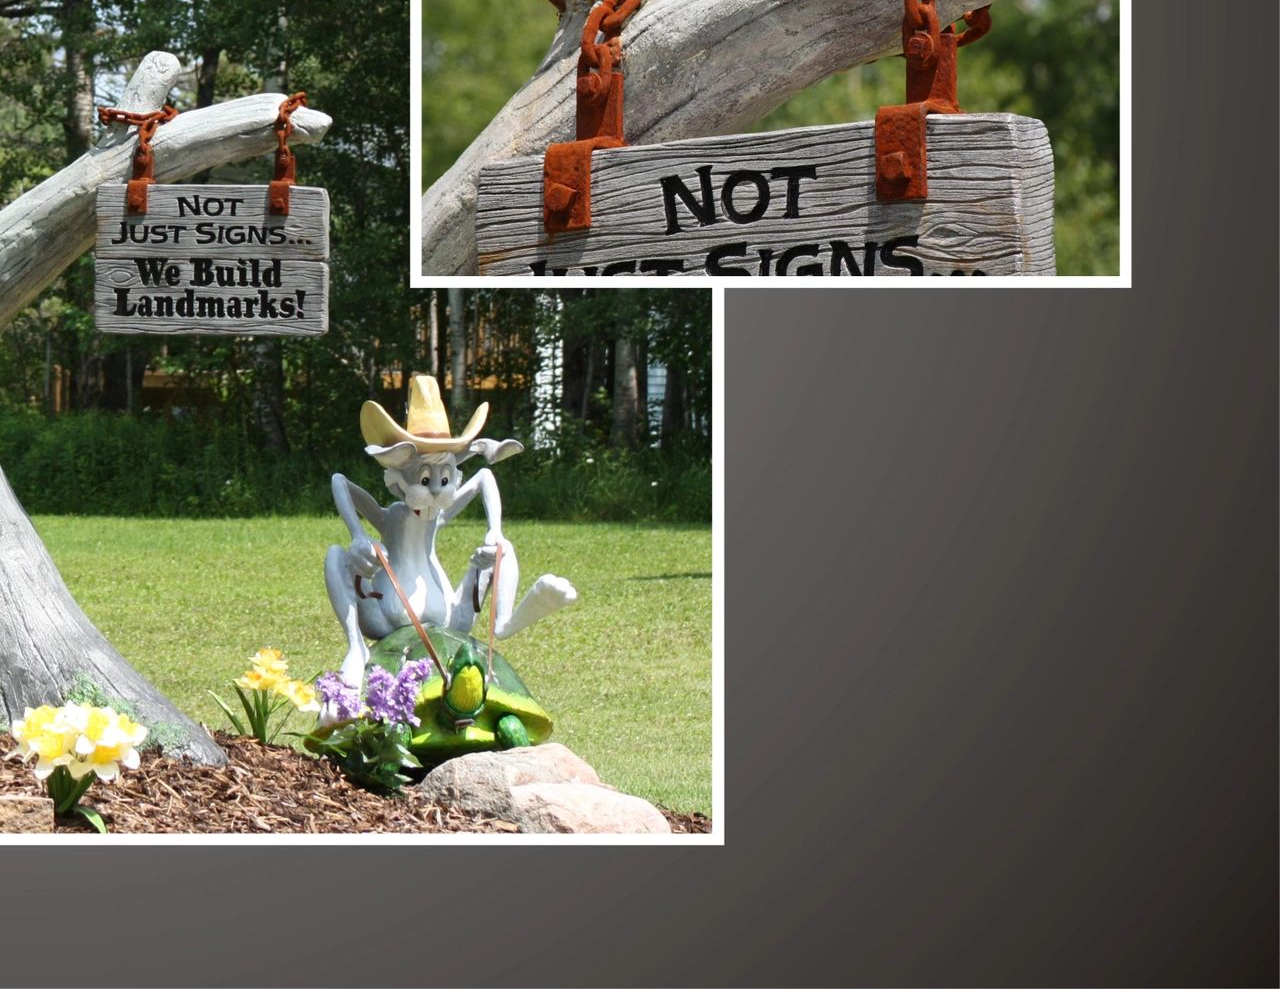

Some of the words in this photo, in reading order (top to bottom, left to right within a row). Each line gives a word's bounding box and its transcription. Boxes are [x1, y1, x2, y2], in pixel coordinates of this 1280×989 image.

[177, 195, 244, 217] NOT
[661, 165, 818, 235] NOT
[111, 222, 187, 244] JUST
[195, 222, 312, 245] SIGNS...
[705, 235, 986, 276] SIGNS..
[134, 258, 180, 286] We
[189, 258, 282, 287] Build
[113, 288, 306, 318] Landmarks!
